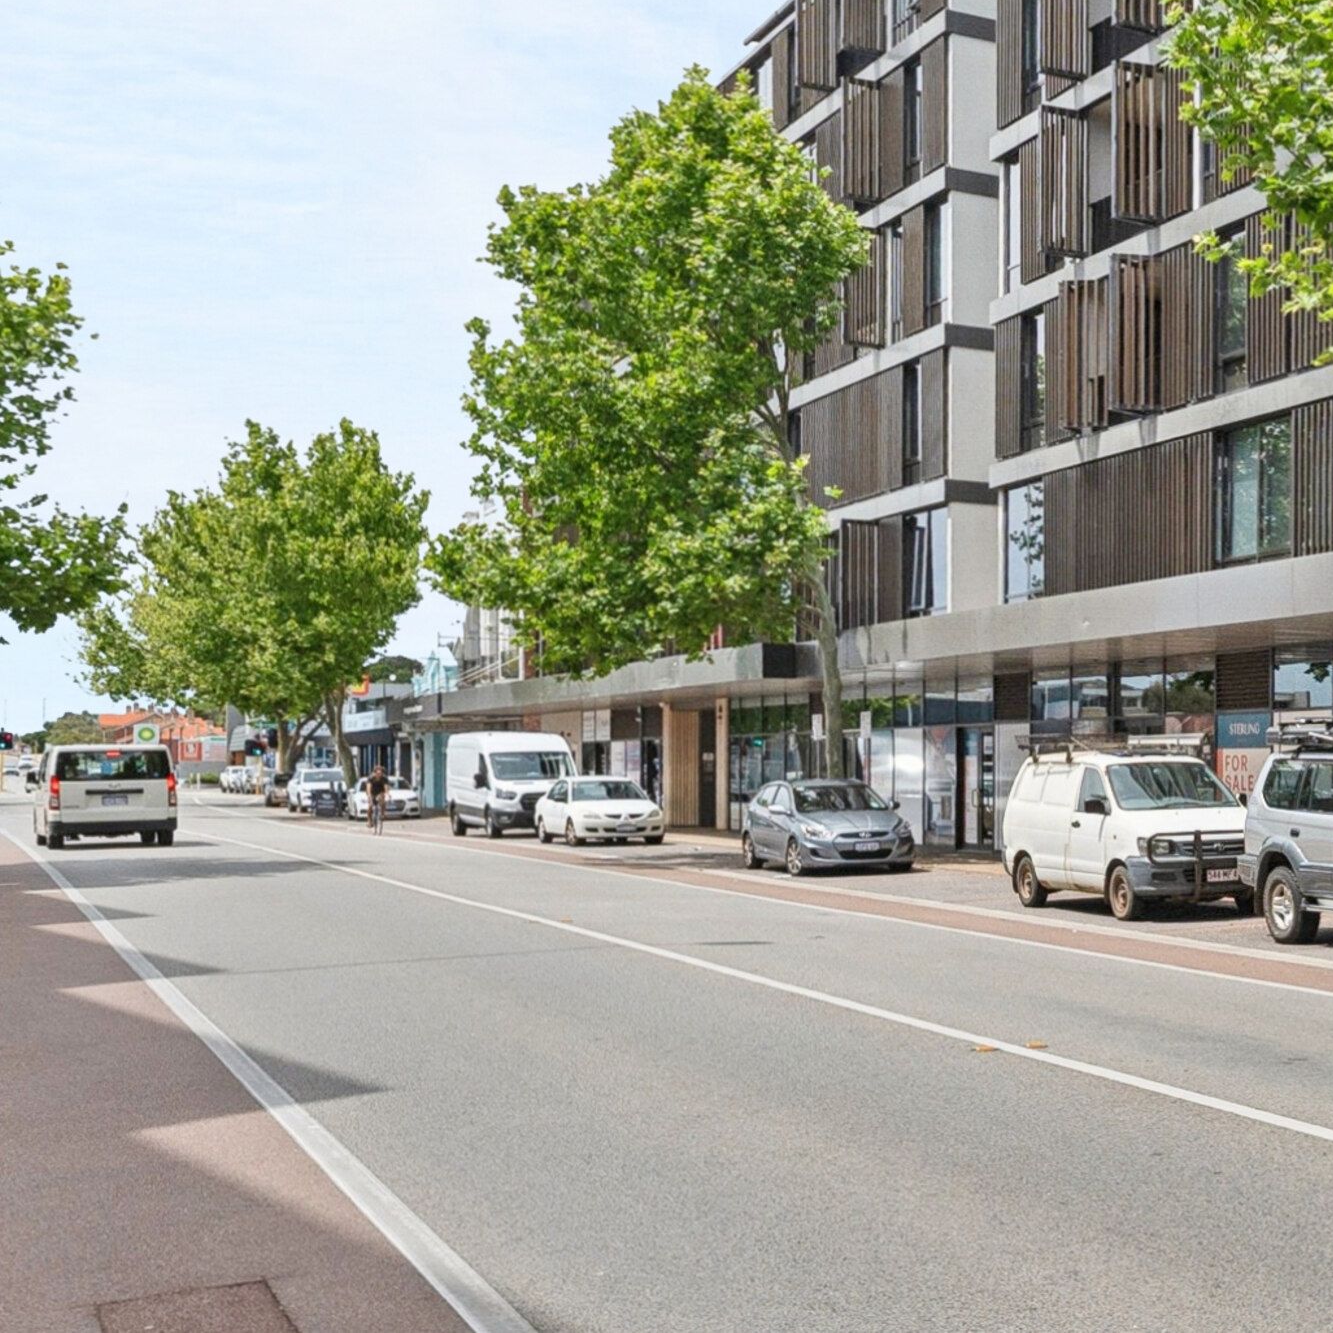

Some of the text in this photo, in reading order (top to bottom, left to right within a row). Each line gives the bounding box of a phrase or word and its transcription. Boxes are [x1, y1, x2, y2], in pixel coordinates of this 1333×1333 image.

[1229, 721, 1261, 736] STERLING
[1225, 754, 1248, 772] FOR
[1225, 773, 1254, 792] SALE
